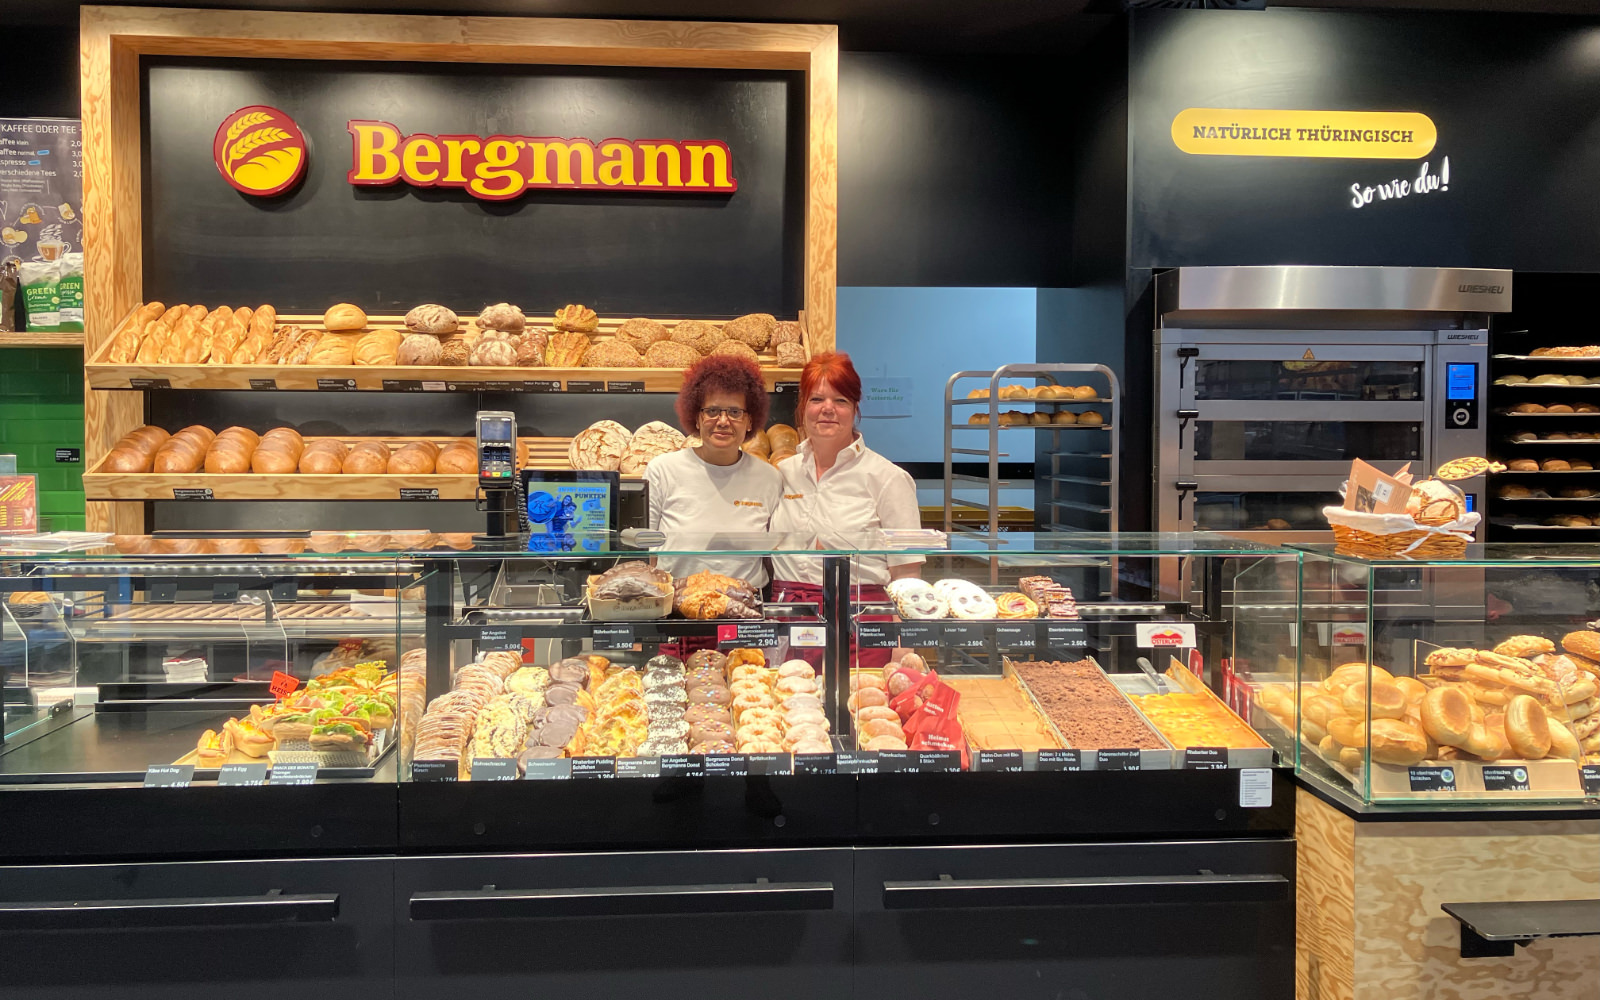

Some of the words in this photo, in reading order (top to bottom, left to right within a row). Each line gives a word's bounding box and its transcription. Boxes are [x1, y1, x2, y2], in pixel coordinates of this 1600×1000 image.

[1, 124, 33, 133] KAFFEE
[36, 125, 59, 134] ODER
[61, 125, 77, 134] TEE
[1193, 123, 1291, 141] NATÜRLICH
[1297, 125, 1414, 143] THÜRINGISCH
[0, 148, 16, 156] affee
[349, 120, 736, 196] Bergmann
[41, 169, 57, 177] Tees
[1352, 182, 1377, 209] So
[1379, 178, 1411, 201] wie
[1414, 155, 1449, 194] du!
[26, 287, 57, 296] GREEN
[1458, 284, 1504, 294] WIESHEU
